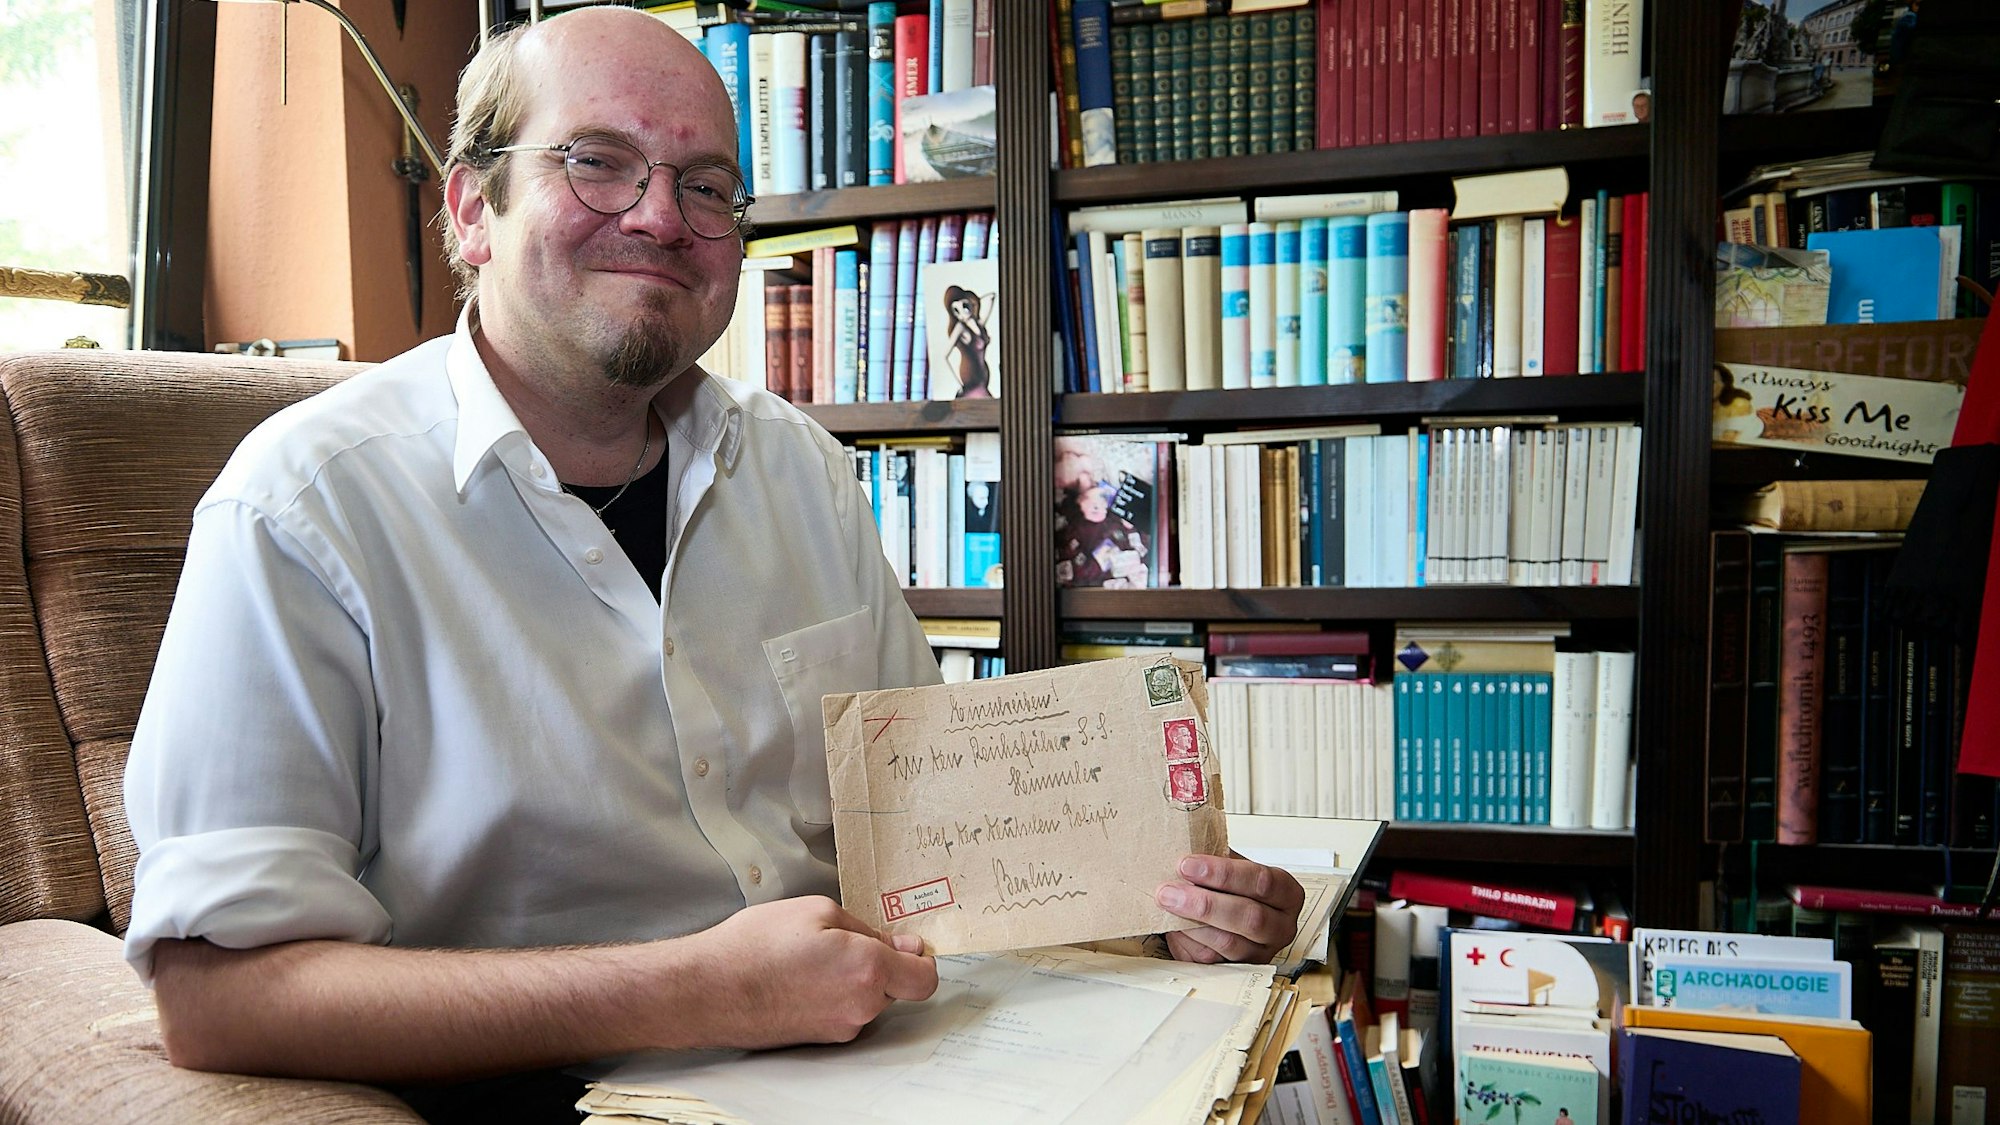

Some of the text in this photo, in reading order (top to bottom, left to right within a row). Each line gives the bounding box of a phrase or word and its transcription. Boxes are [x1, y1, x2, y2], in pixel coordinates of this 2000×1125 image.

[1742, 371, 1836, 393] Always
[1773, 393, 1910, 433] Kiss Me
[1825, 432, 1940, 456] Goodnight
[1800, 613, 1821, 661] 1493
[1401, 681, 1408, 694] 1
[1414, 681, 1424, 694] 2
[1432, 681, 1442, 694] 3
[1452, 681, 1462, 694] 4
[1470, 681, 1480, 694] 5
[1485, 681, 1495, 694] 6
[1499, 681, 1507, 694] 7
[1510, 681, 1520, 694] 8
[1523, 681, 1532, 694] 9
[1535, 681, 1548, 694] 10
[1007, 764, 1103, 797] Himmler
[1062, 800, 1119, 841] Polizei
[913, 890, 932, 903] Aachen
[1471, 885, 1502, 900] THILO
[1501, 891, 1557, 911] SARRAZIN
[886, 894, 906, 919] R
[1930, 904, 1975, 917] Deutsche
[1682, 970, 1829, 993] ARCHÄOLOGIE
[1307, 1032, 1320, 1043] 47
[1473, 1062, 1504, 1073] ANNA
[1507, 1067, 1541, 1078] MARIA
